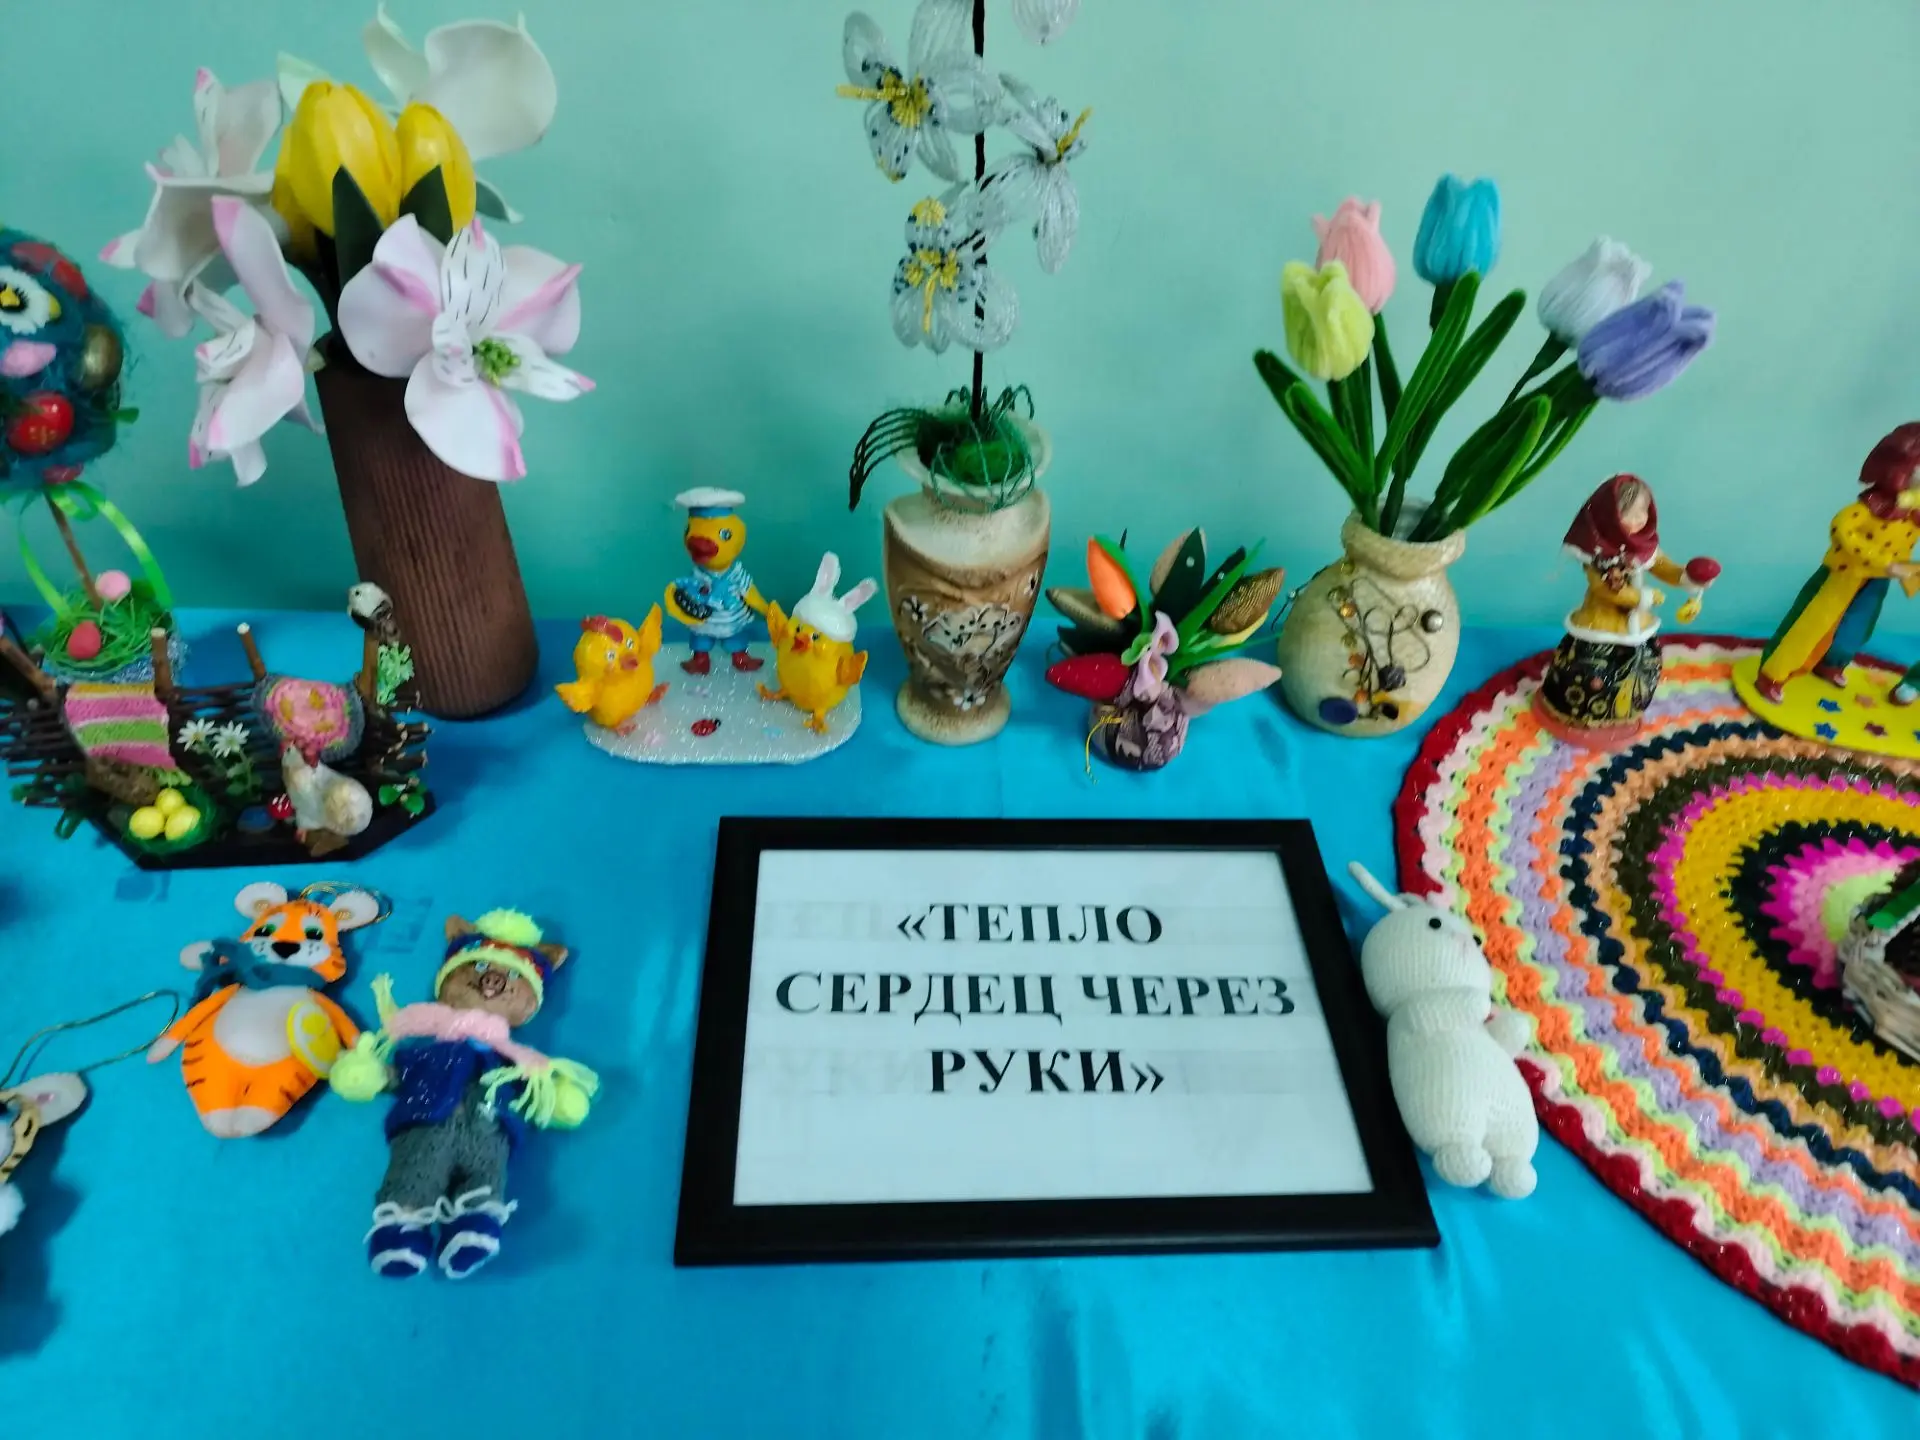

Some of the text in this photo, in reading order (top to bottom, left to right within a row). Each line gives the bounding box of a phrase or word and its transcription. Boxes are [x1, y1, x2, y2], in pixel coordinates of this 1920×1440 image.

[896, 904, 1163, 943] «ТЕПЛО
[775, 972, 1296, 1025] СЕРДЕЦ ЧЕРЕЗ
[928, 1049, 1164, 1094] РУКИ»
